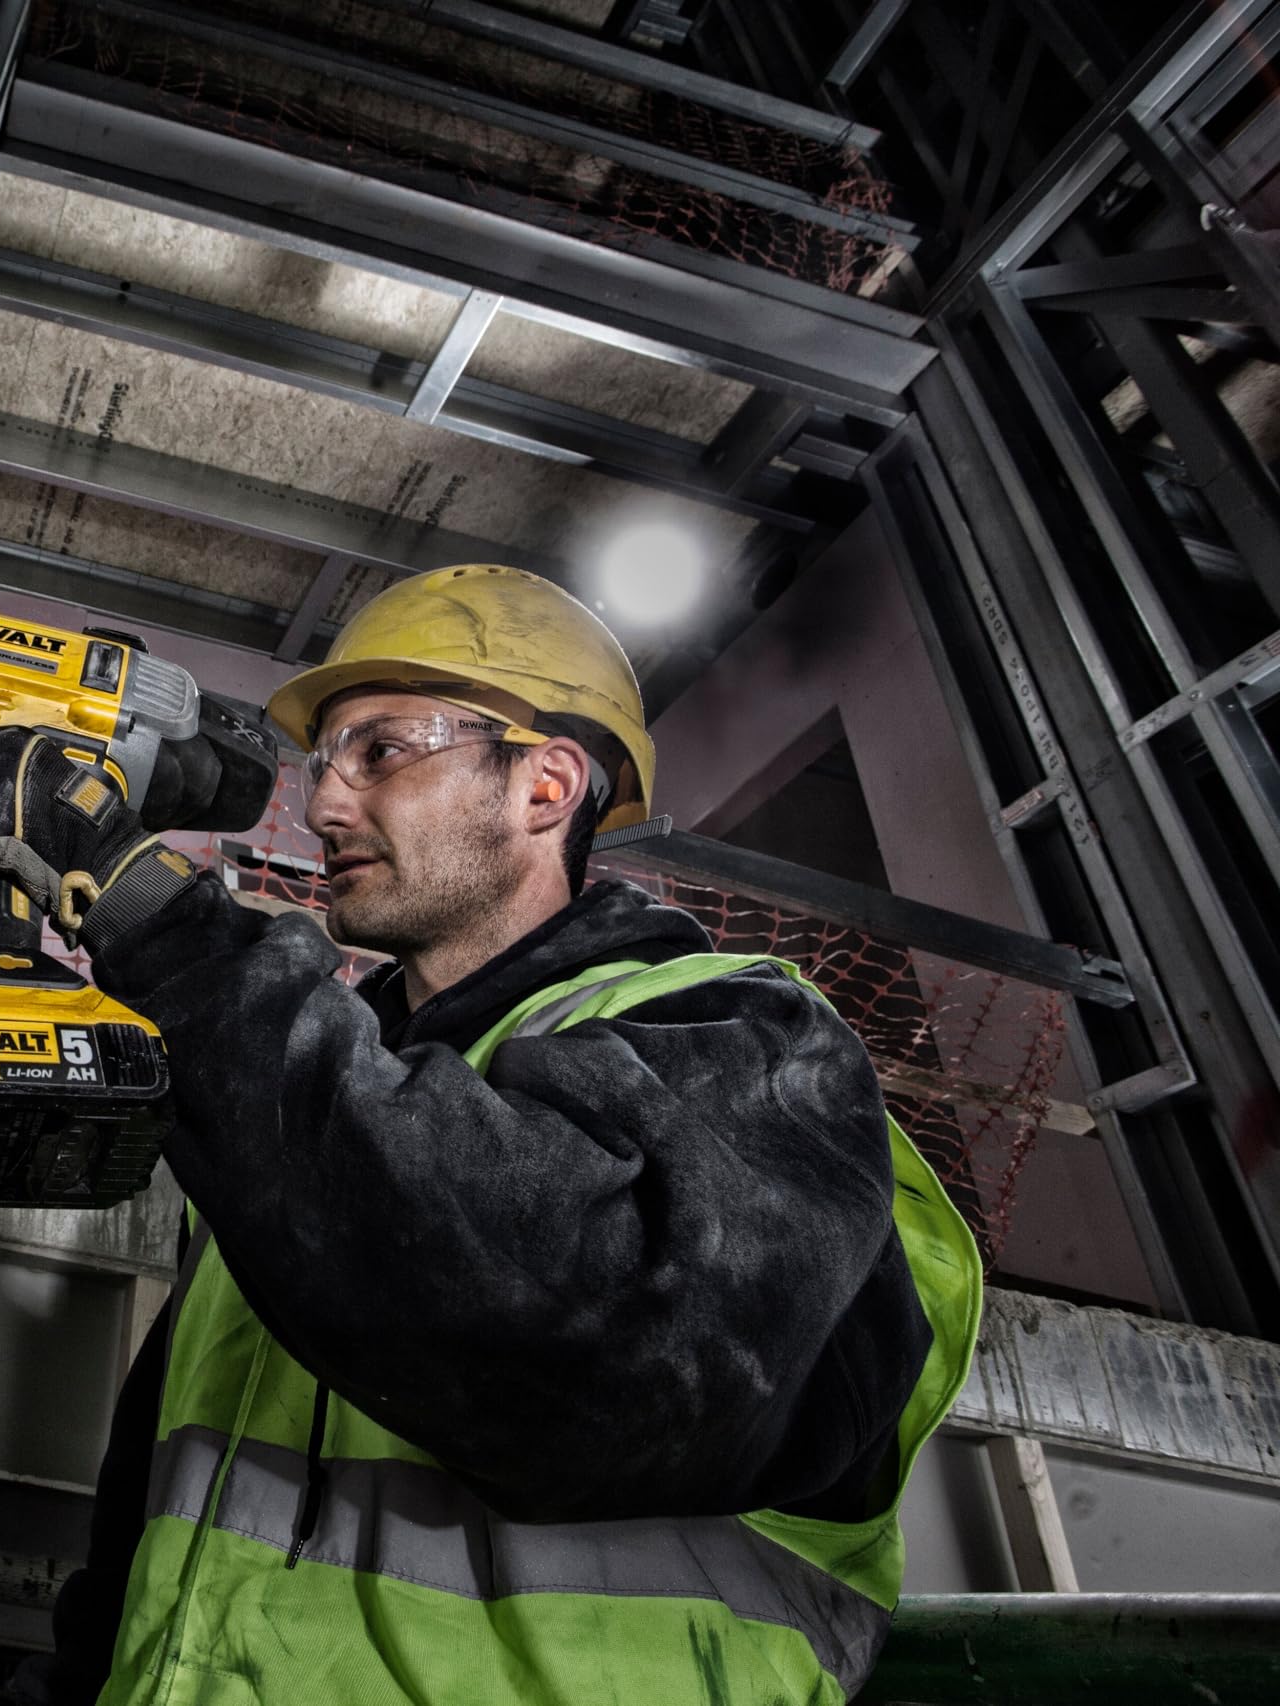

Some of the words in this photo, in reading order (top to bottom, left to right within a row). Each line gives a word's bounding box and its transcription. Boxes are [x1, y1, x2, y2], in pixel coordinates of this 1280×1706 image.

[60, 1029, 93, 1065] 5
[7, 1067, 53, 1079] LI-ION
[66, 1067, 97, 1081] AH
